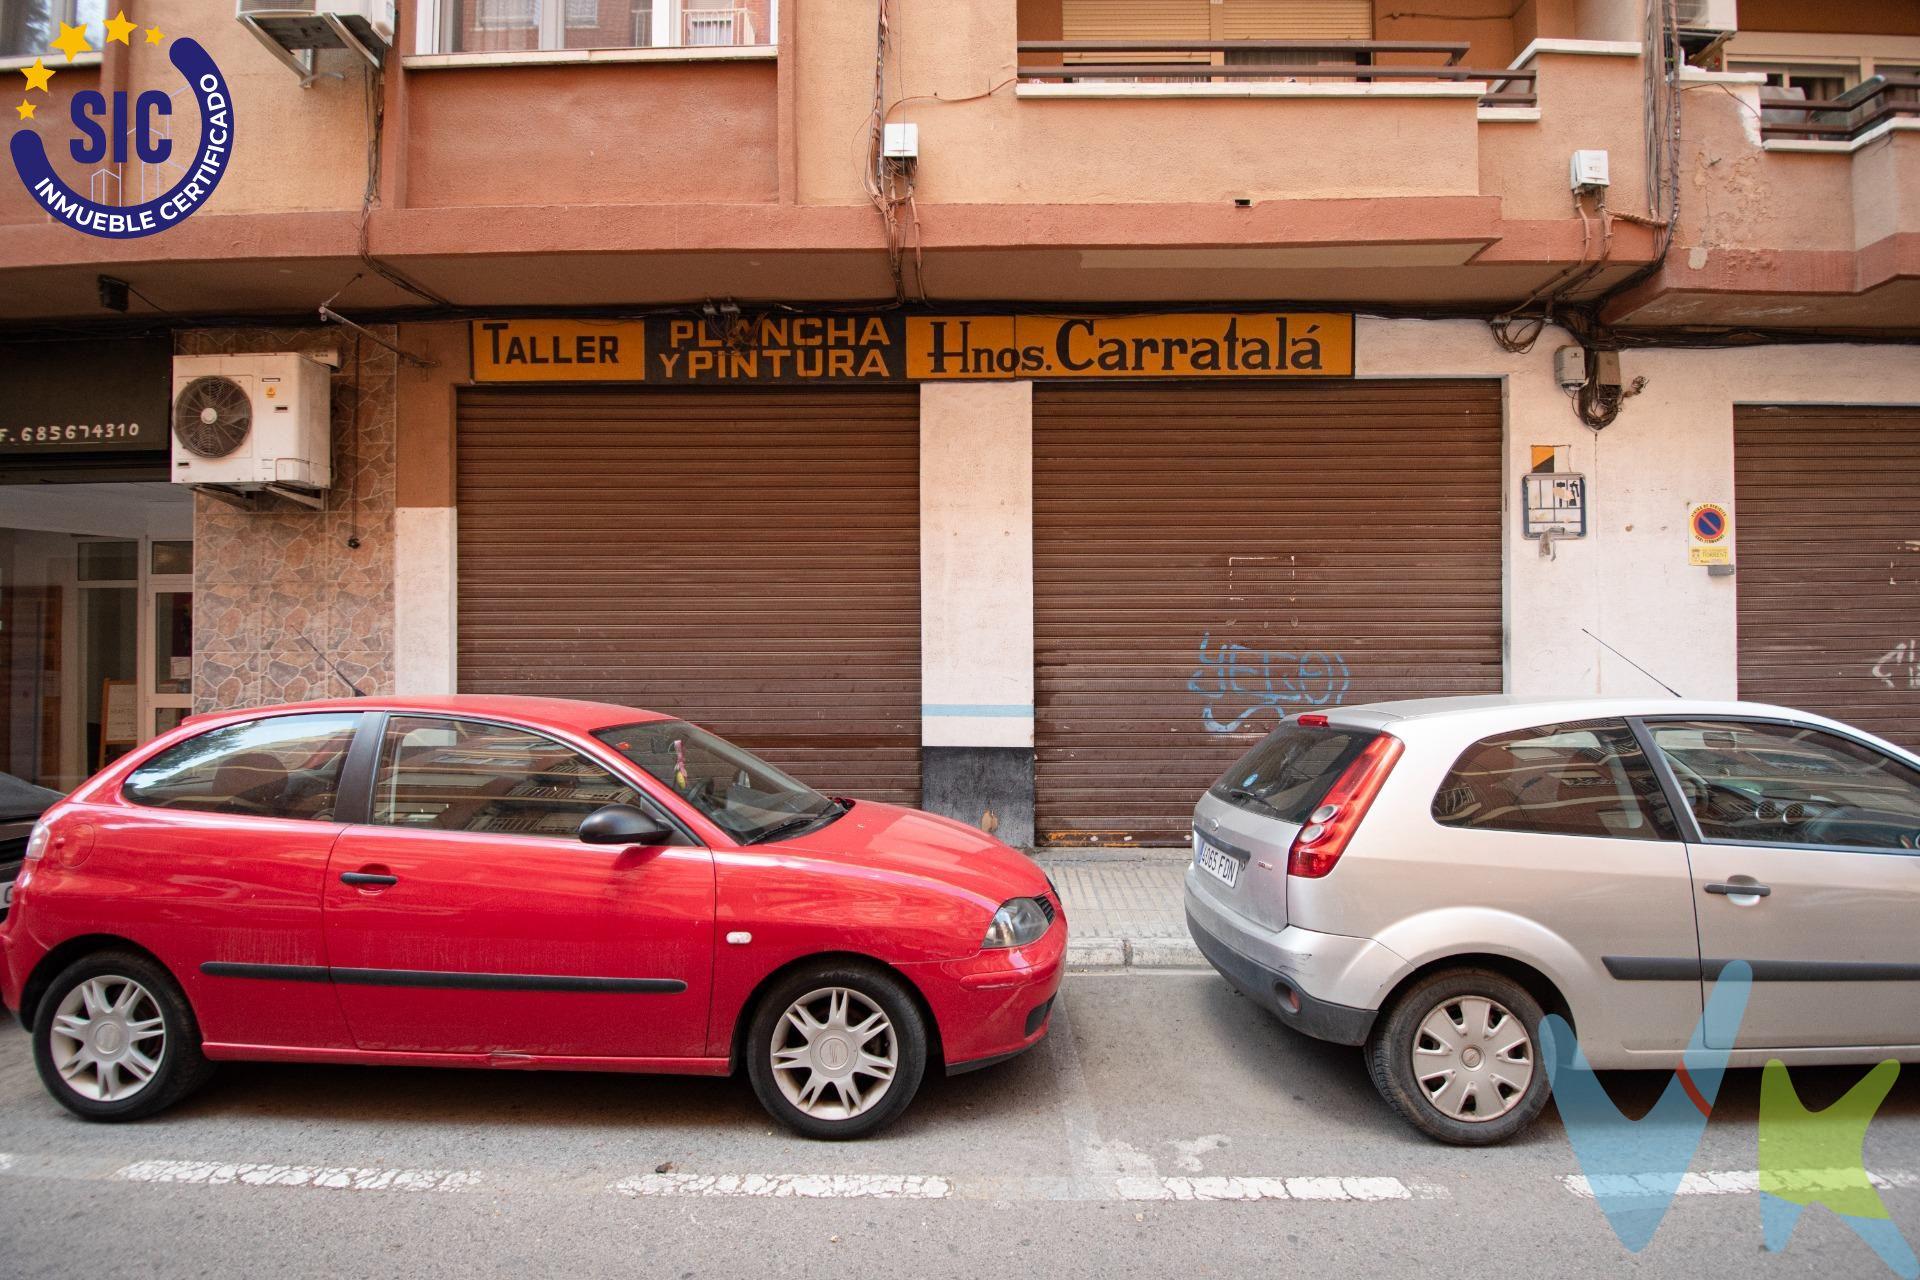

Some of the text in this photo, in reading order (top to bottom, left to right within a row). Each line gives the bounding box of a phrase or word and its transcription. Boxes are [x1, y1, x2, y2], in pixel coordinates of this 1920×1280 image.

[688, 349, 891, 378] PINTURA
[927, 317, 1323, 374] Hnos. Carratalá
